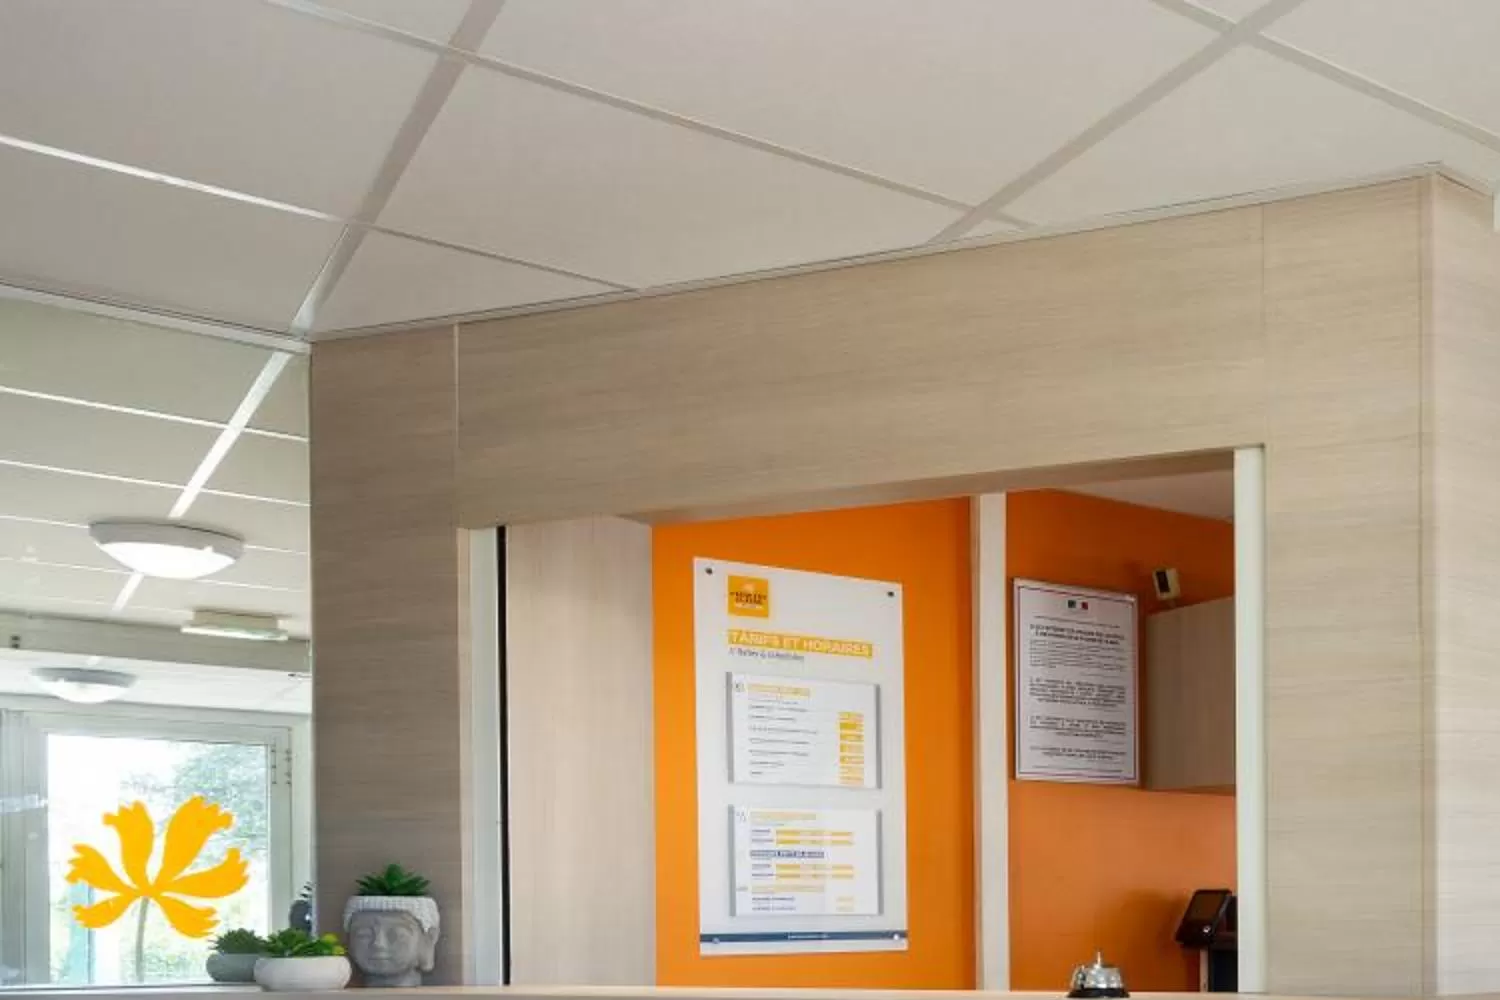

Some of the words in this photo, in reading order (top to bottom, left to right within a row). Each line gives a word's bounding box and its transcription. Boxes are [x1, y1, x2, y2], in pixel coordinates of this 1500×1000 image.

[732, 631, 780, 646] TARIFS
[783, 636, 801, 648] ET
[803, 639, 869, 655] HORAIRES
